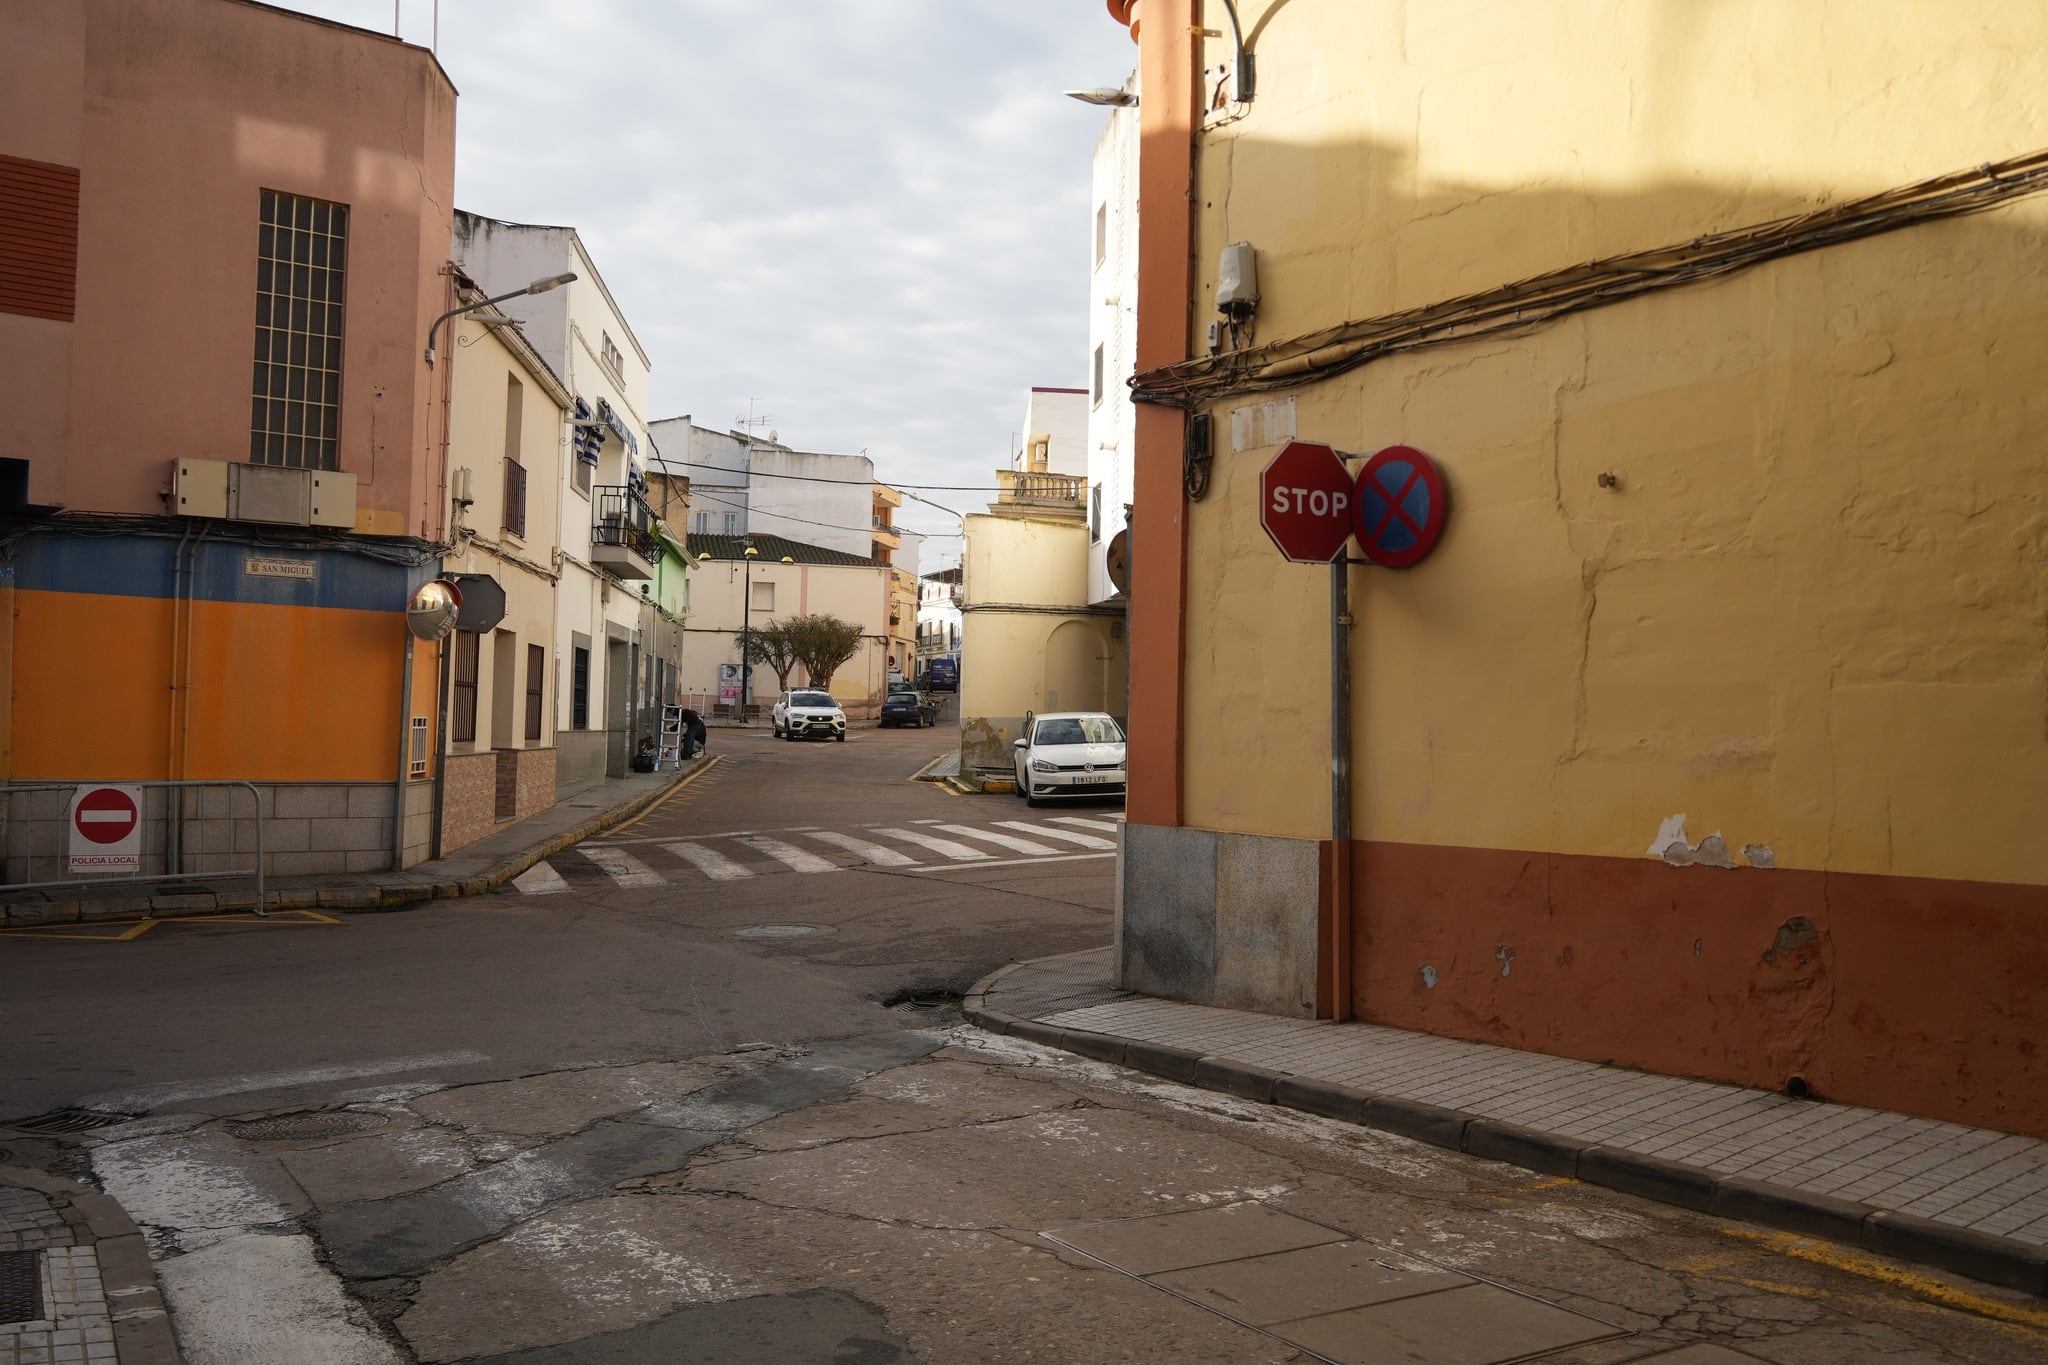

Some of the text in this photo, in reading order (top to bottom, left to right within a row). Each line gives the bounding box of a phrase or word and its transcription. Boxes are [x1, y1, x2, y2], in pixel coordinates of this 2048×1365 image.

[1272, 485, 1348, 517] STOP
[262, 564, 310, 575] SAN MIGUEL
[71, 856, 137, 865] POLICIA LOCAL
